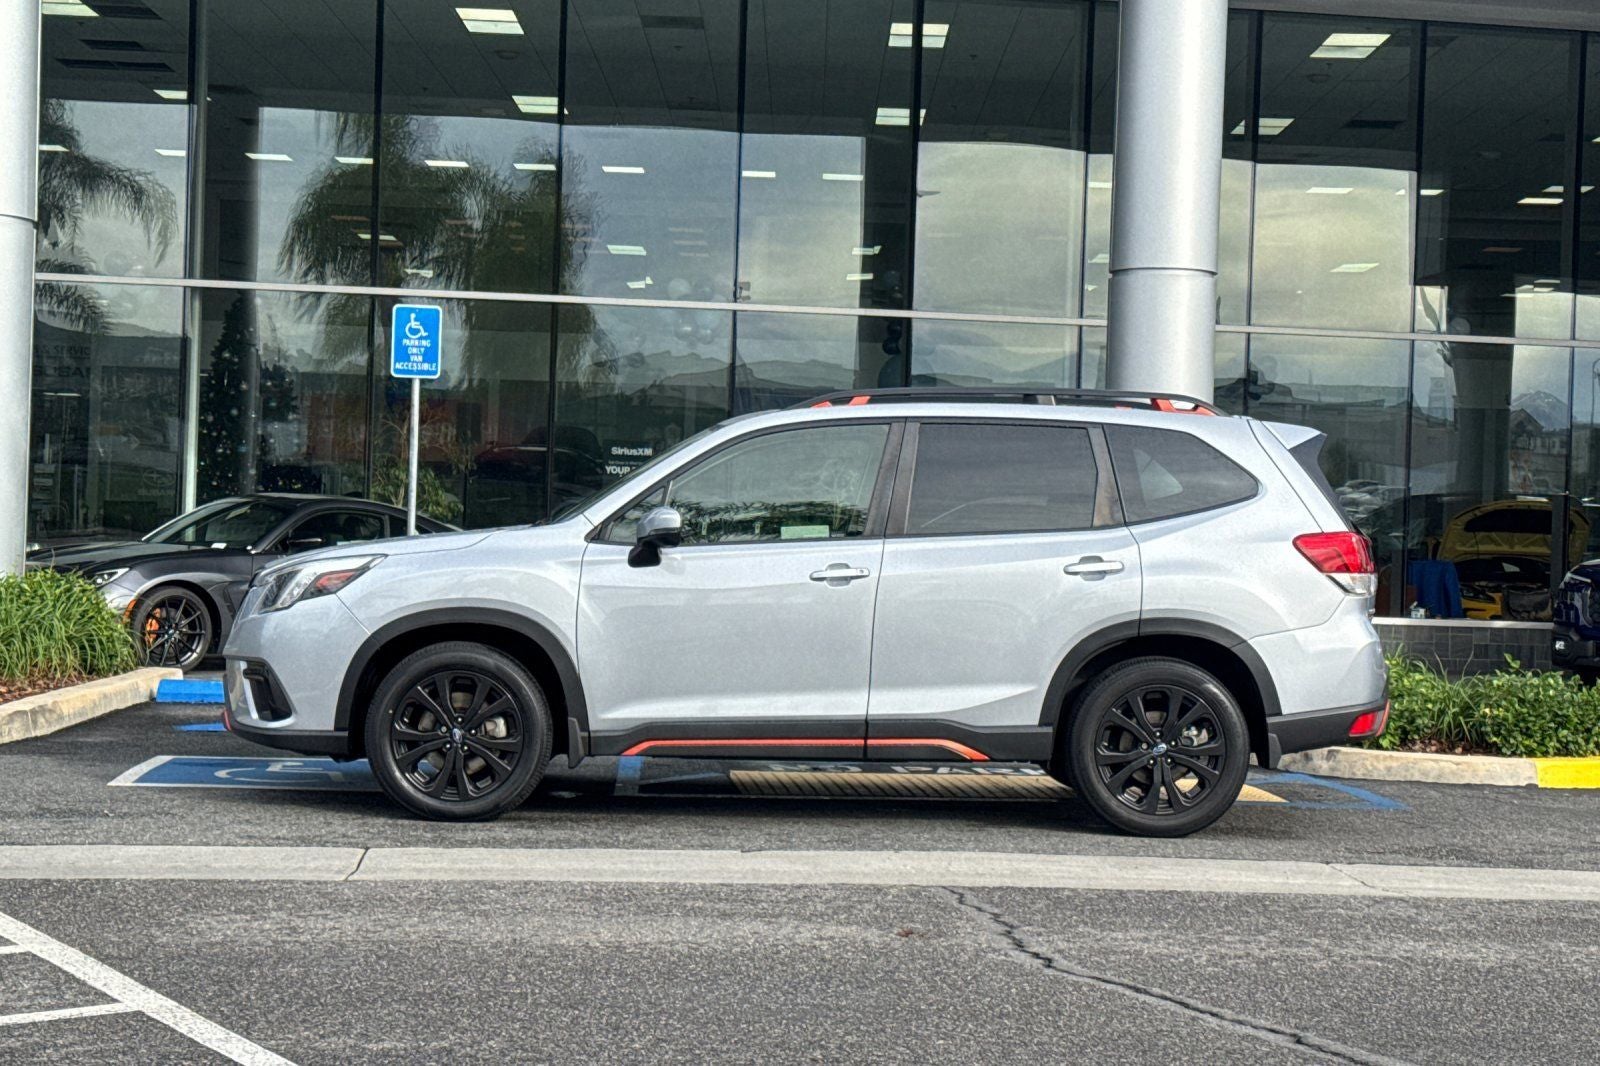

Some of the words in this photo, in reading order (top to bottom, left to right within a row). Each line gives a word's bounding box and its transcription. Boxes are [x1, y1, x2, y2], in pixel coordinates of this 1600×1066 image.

[402, 338, 431, 347] PARKING
[395, 362, 437, 371] ACCESSIBLE
[611, 446, 654, 456] SiriusXM
